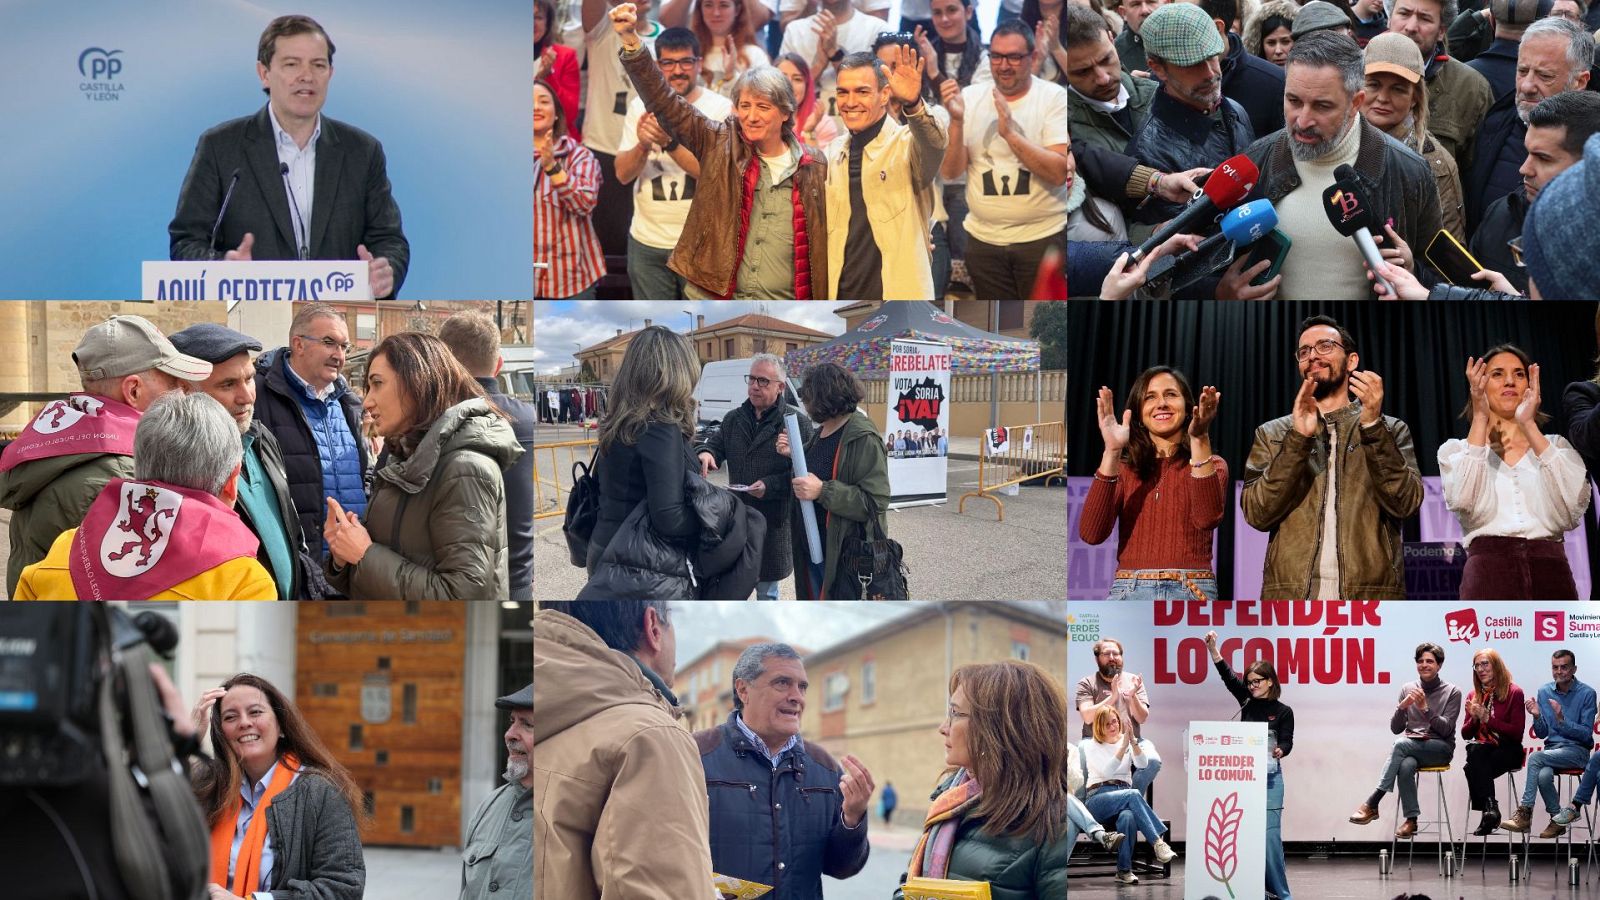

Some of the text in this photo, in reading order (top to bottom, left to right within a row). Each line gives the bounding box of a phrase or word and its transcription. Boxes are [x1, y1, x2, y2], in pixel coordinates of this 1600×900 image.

[79, 83, 125, 91] CASTILLA
[86, 91, 119, 101] Y LEÓN
[893, 345, 902, 353] POR
[895, 378, 912, 390] VOTA
[915, 387, 939, 400] SORIA
[899, 399, 939, 420] ¡YA!
[1404, 546, 1461, 557] Podemos
[1485, 616, 1522, 627] Castilla
[1072, 634, 1100, 642] EQUO
[1485, 628, 1519, 641] y León
[1154, 637, 1208, 684] LO
[1199, 755, 1254, 767] DEFENDER
[1198, 766, 1256, 781] LO COMÚN.
